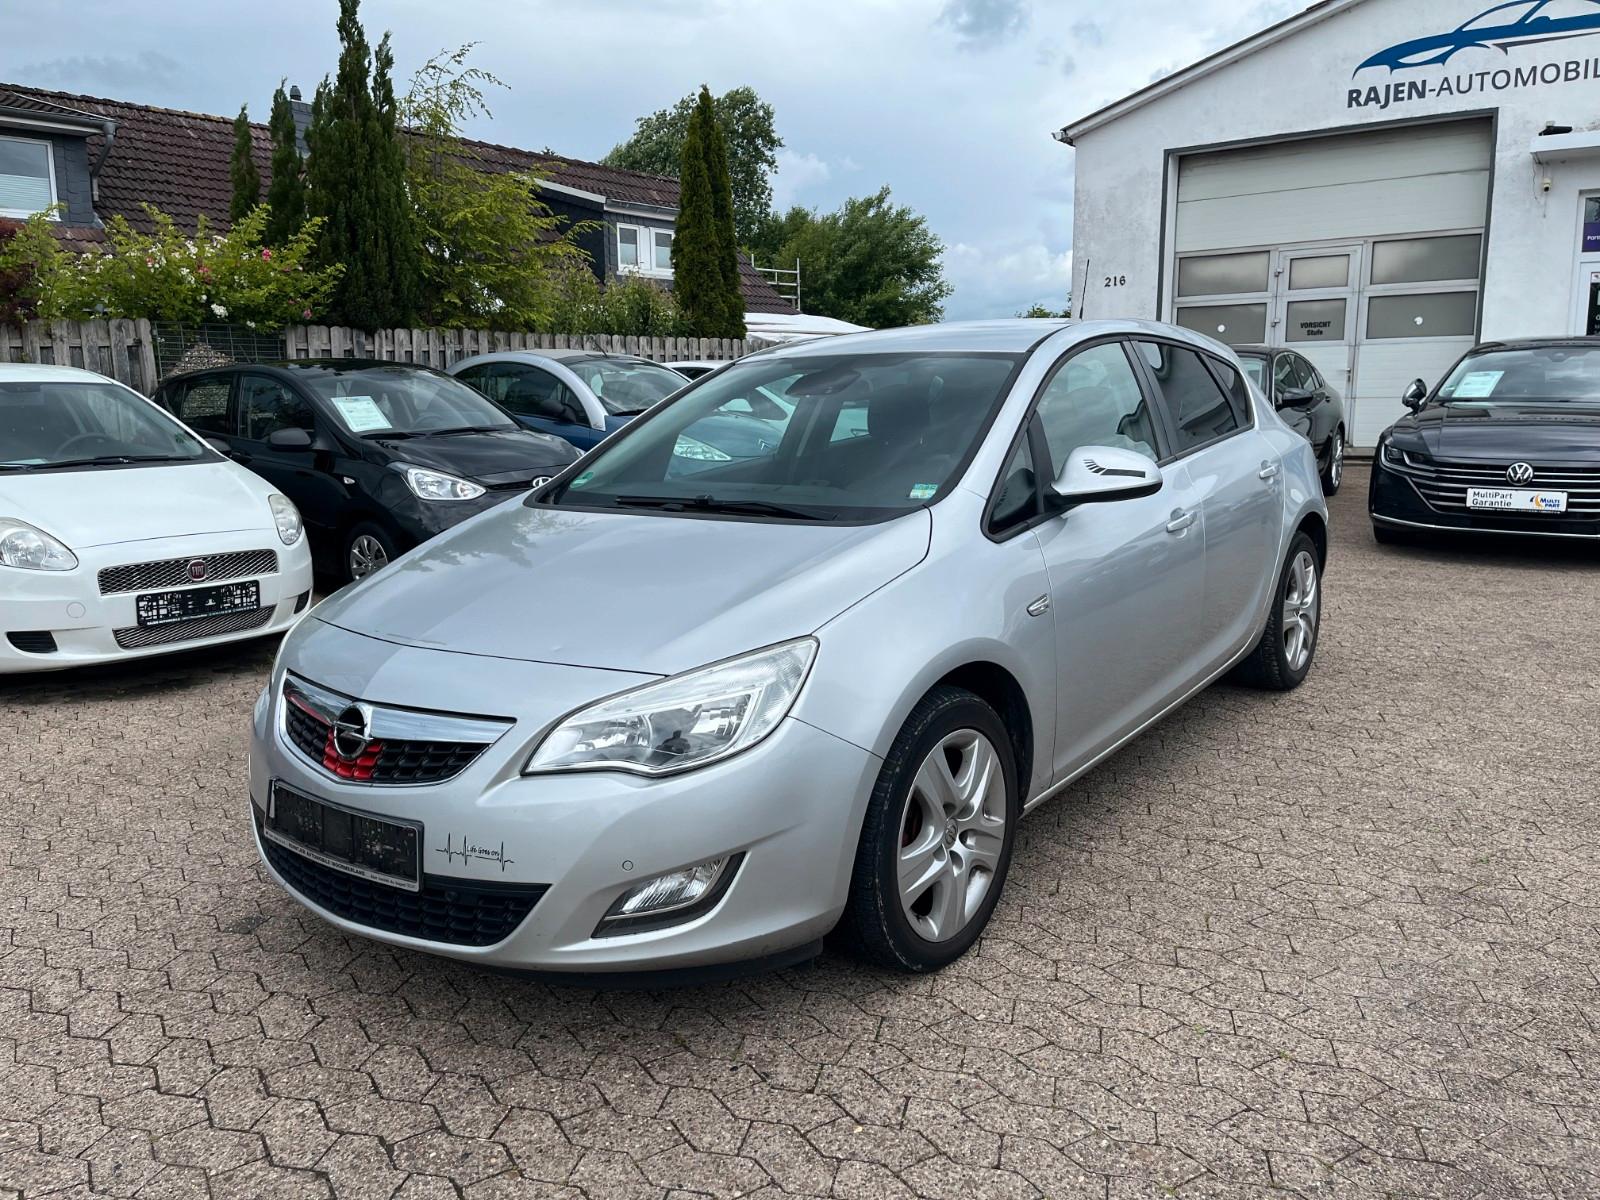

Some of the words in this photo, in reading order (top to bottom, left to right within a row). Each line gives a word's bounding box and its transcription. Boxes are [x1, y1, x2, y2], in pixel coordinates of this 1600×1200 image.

[1104, 275, 1126, 287] 216
[1300, 321, 1331, 329] VORSICHT
[1473, 491, 1513, 500] MultiPart
[1472, 498, 1512, 507] Garantie
